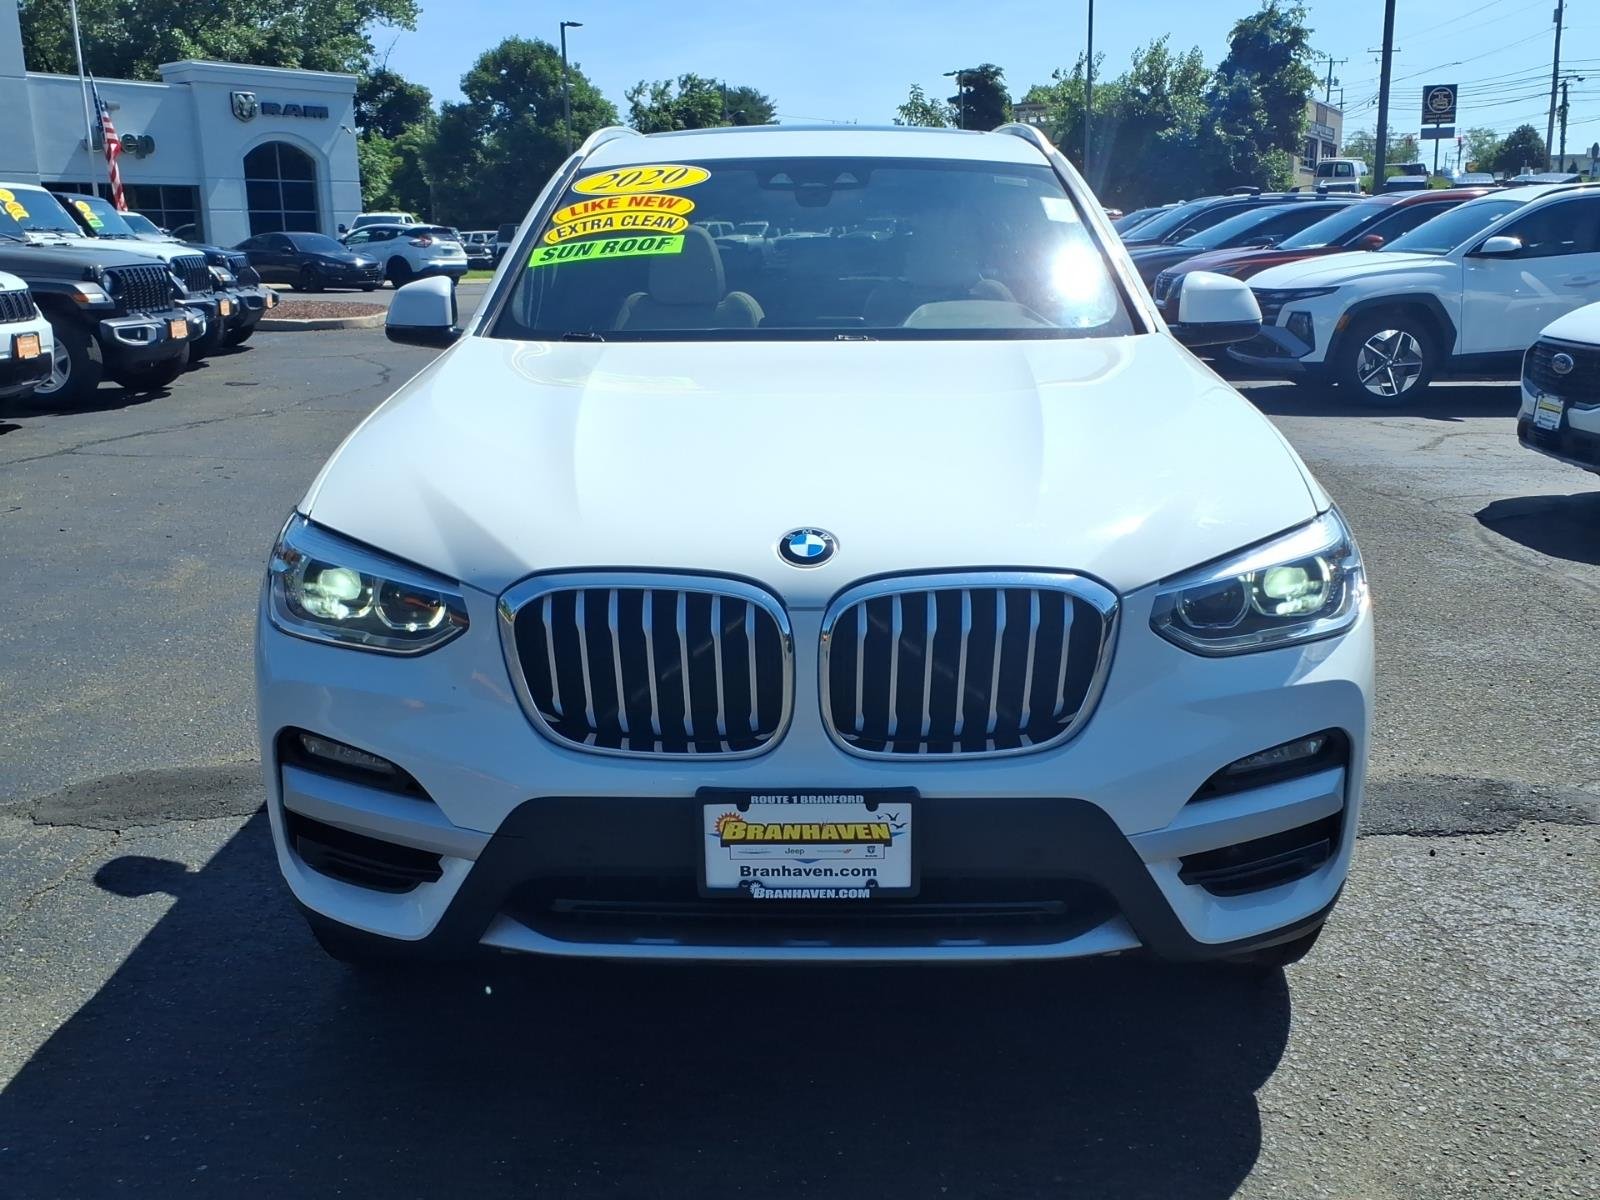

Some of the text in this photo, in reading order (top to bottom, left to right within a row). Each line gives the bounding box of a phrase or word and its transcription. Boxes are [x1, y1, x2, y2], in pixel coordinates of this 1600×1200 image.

[260, 102, 329, 119] RAM
[591, 167, 689, 191] 2020
[569, 196, 682, 217] LIKE NEW
[556, 214, 679, 239] EXTRA CLEAN
[539, 236, 675, 262] SUN ROOF
[750, 794, 865, 804] ROUTE 1 BRANFORD
[721, 820, 891, 840] BRANHAVEN
[784, 847, 805, 856] Jeep
[739, 865, 878, 877] Branhaven.com
[753, 888, 870, 899] BRANHAVEN.COM
